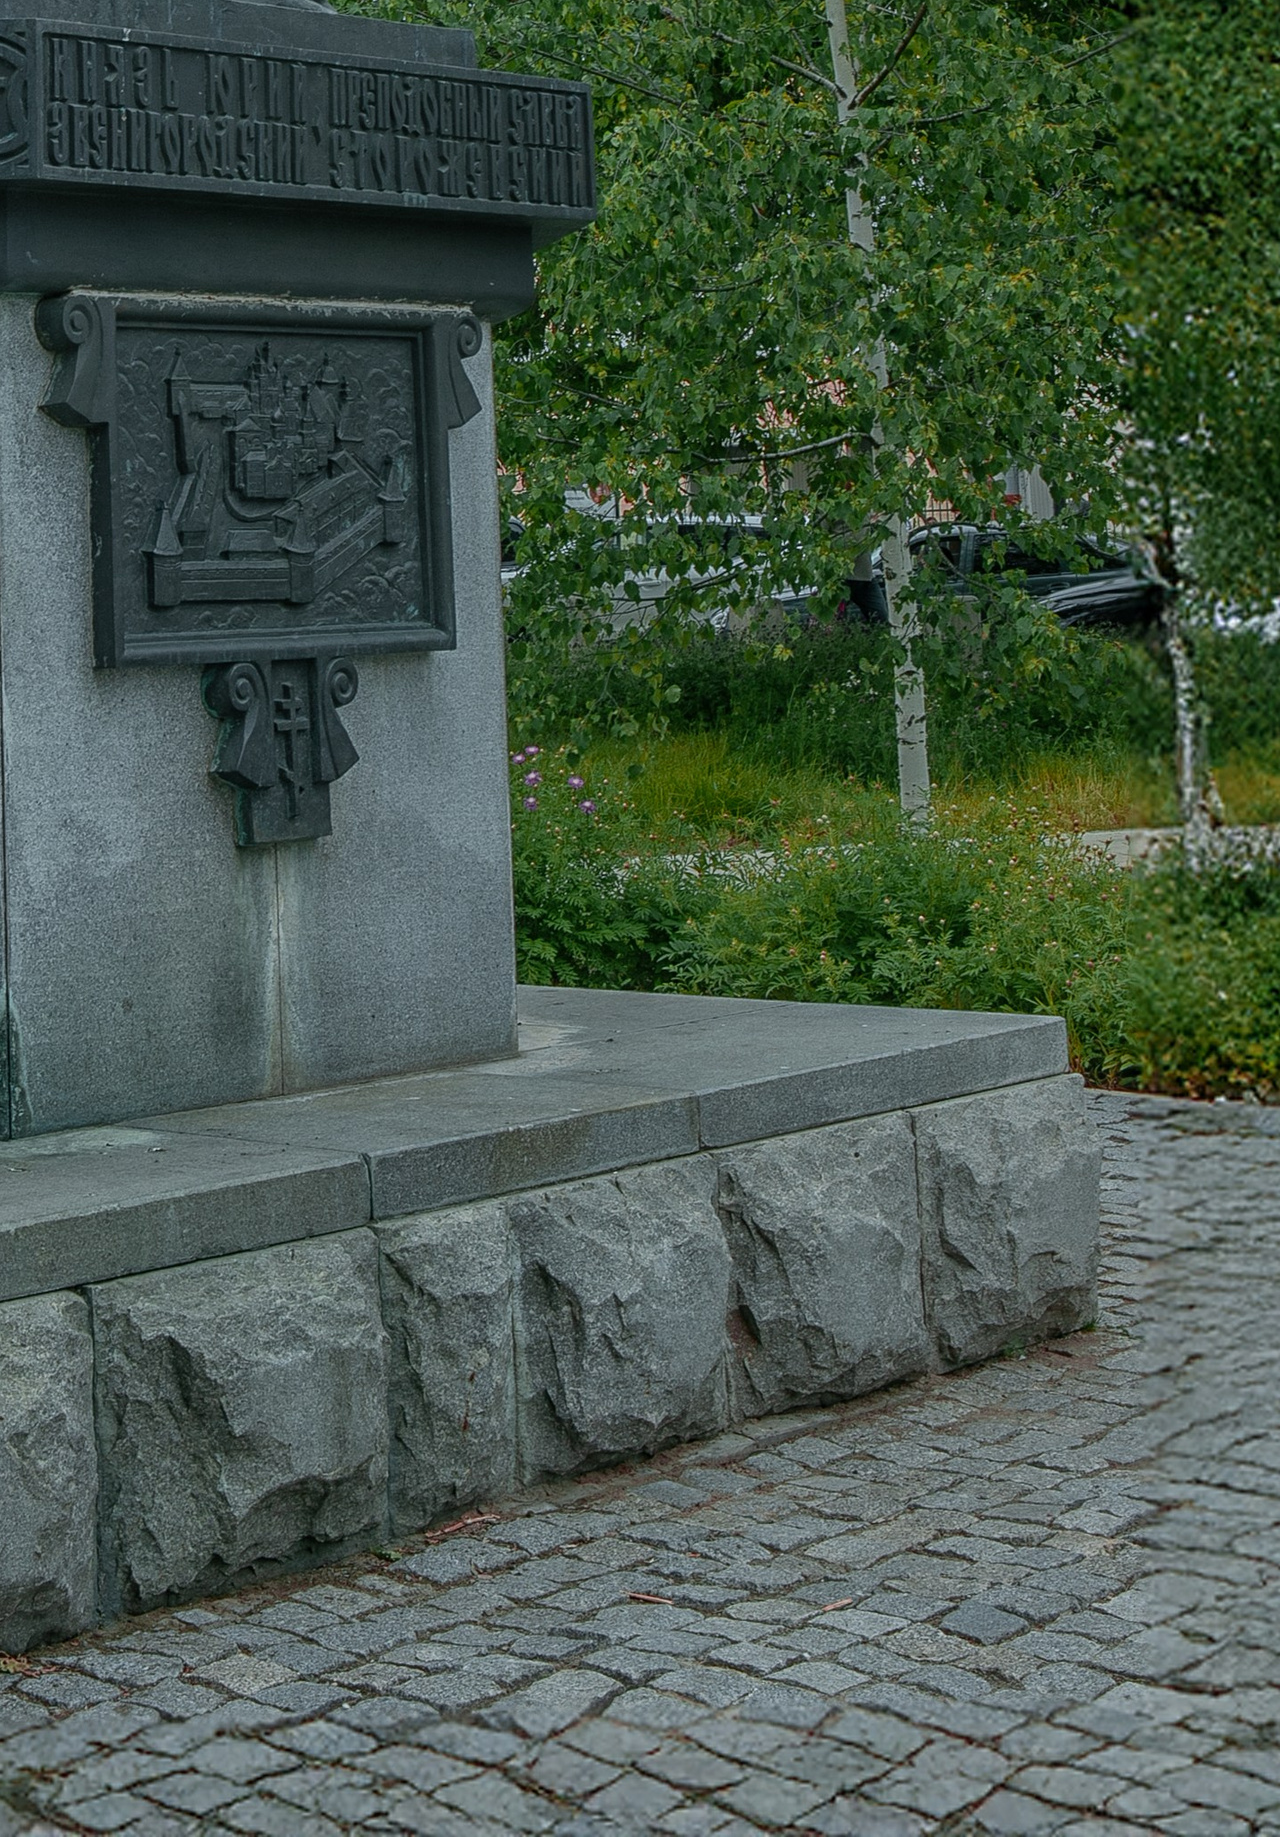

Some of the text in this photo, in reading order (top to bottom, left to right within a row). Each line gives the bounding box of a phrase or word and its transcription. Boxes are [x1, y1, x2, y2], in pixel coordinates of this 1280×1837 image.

[50, 37, 179, 109] КНЯЗЬ
[507, 88, 583, 151] САВВА
[329, 128, 585, 207] СТОРОЖЕВСКИЙ
